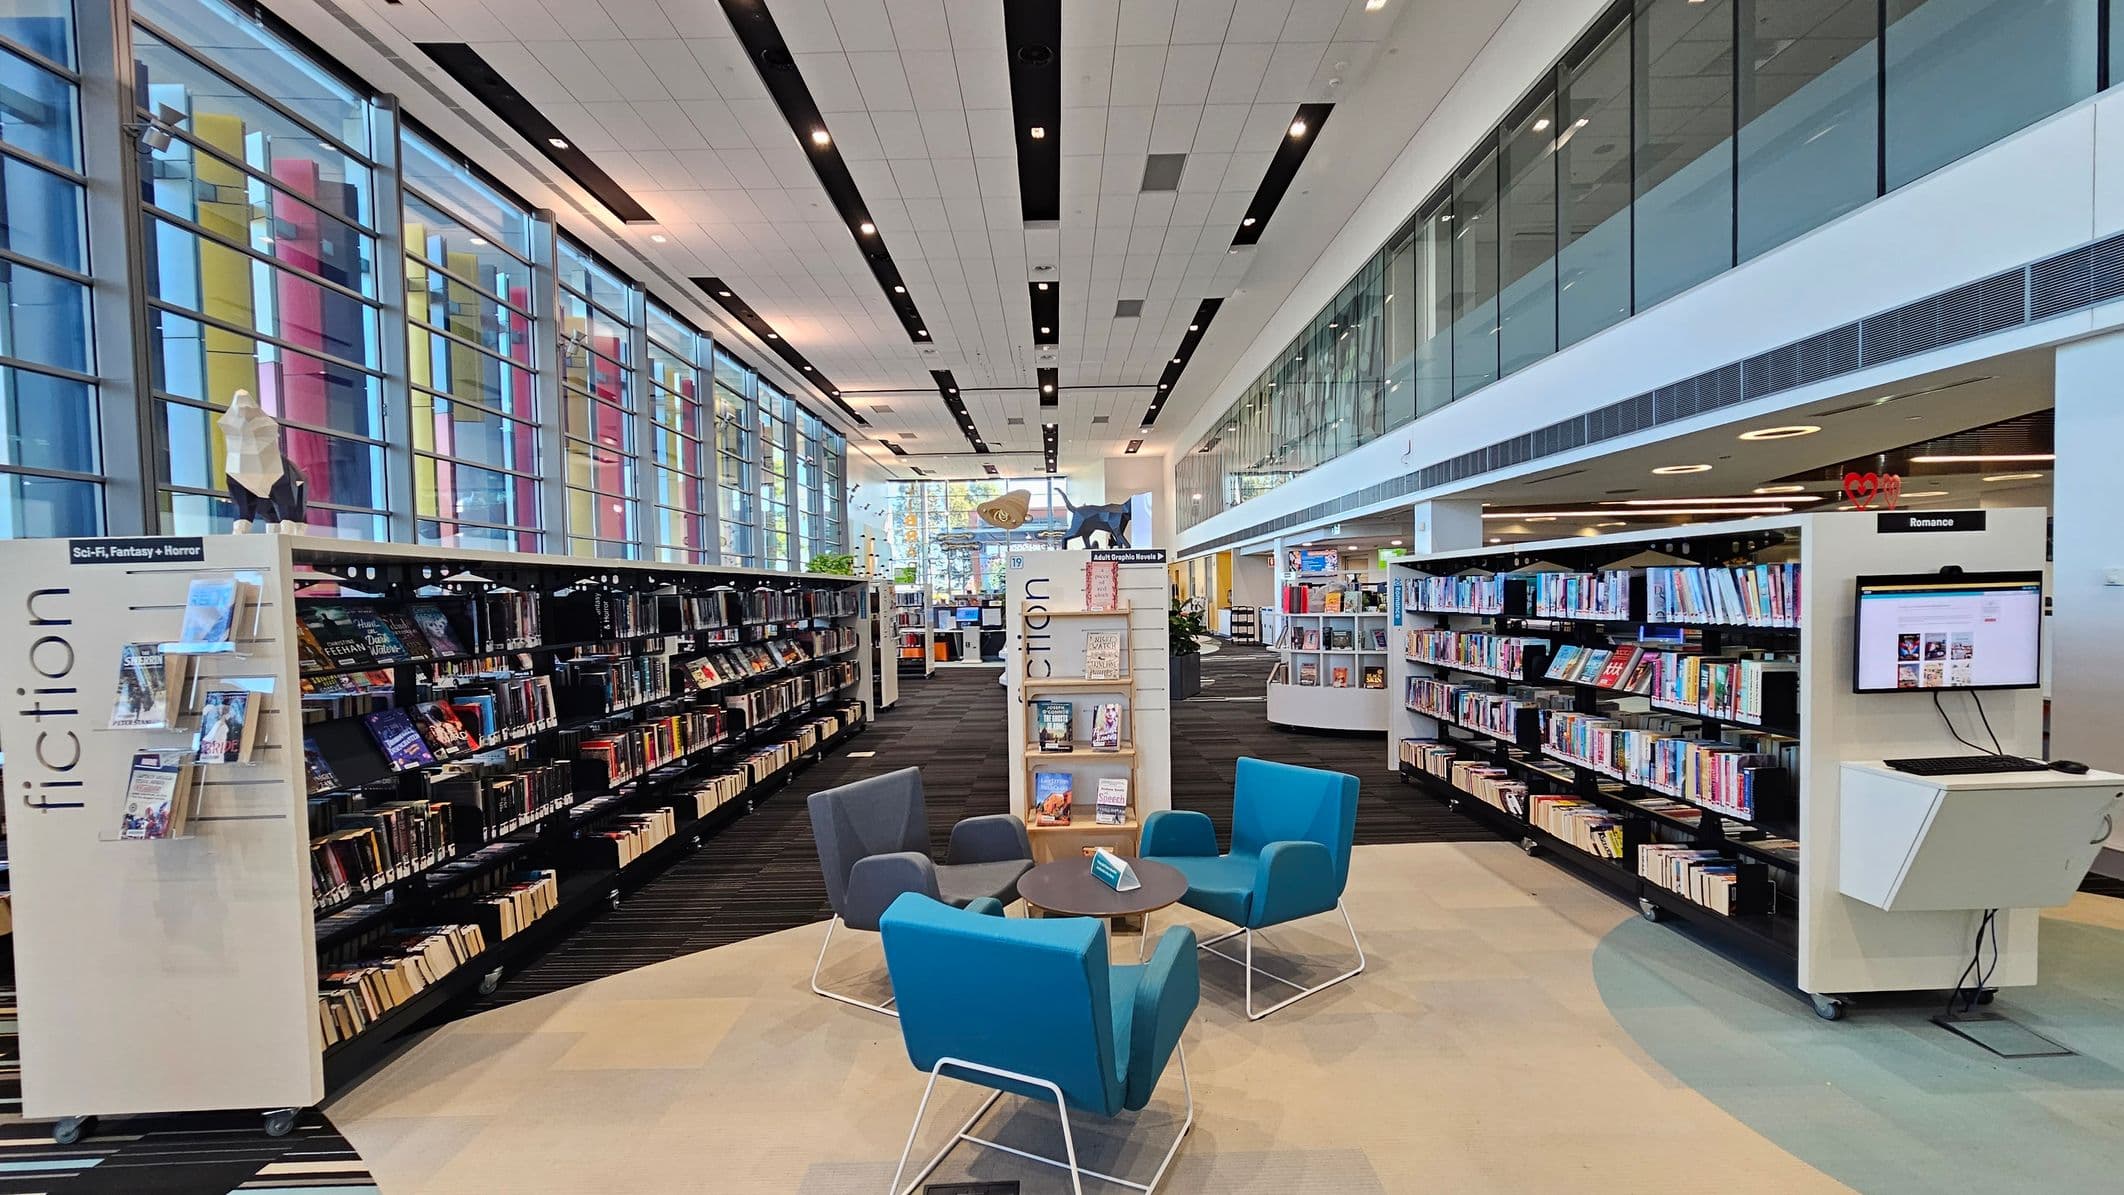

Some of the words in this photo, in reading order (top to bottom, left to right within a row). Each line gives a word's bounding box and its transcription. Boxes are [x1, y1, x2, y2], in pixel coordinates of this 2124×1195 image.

[1909, 516, 1954, 527] Romance
[72, 546, 109, 559] Sci-Fi,
[110, 546, 154, 559] Fantasy
[164, 545, 201, 556] Horror
[1111, 553, 1135, 562] Graphic
[1011, 557, 1023, 568] 19
[1017, 578, 1052, 707] fction
[324, 643, 367, 656] FEEHAN
[16, 588, 85, 814] fiction
[202, 739, 239, 755] BRIDE
